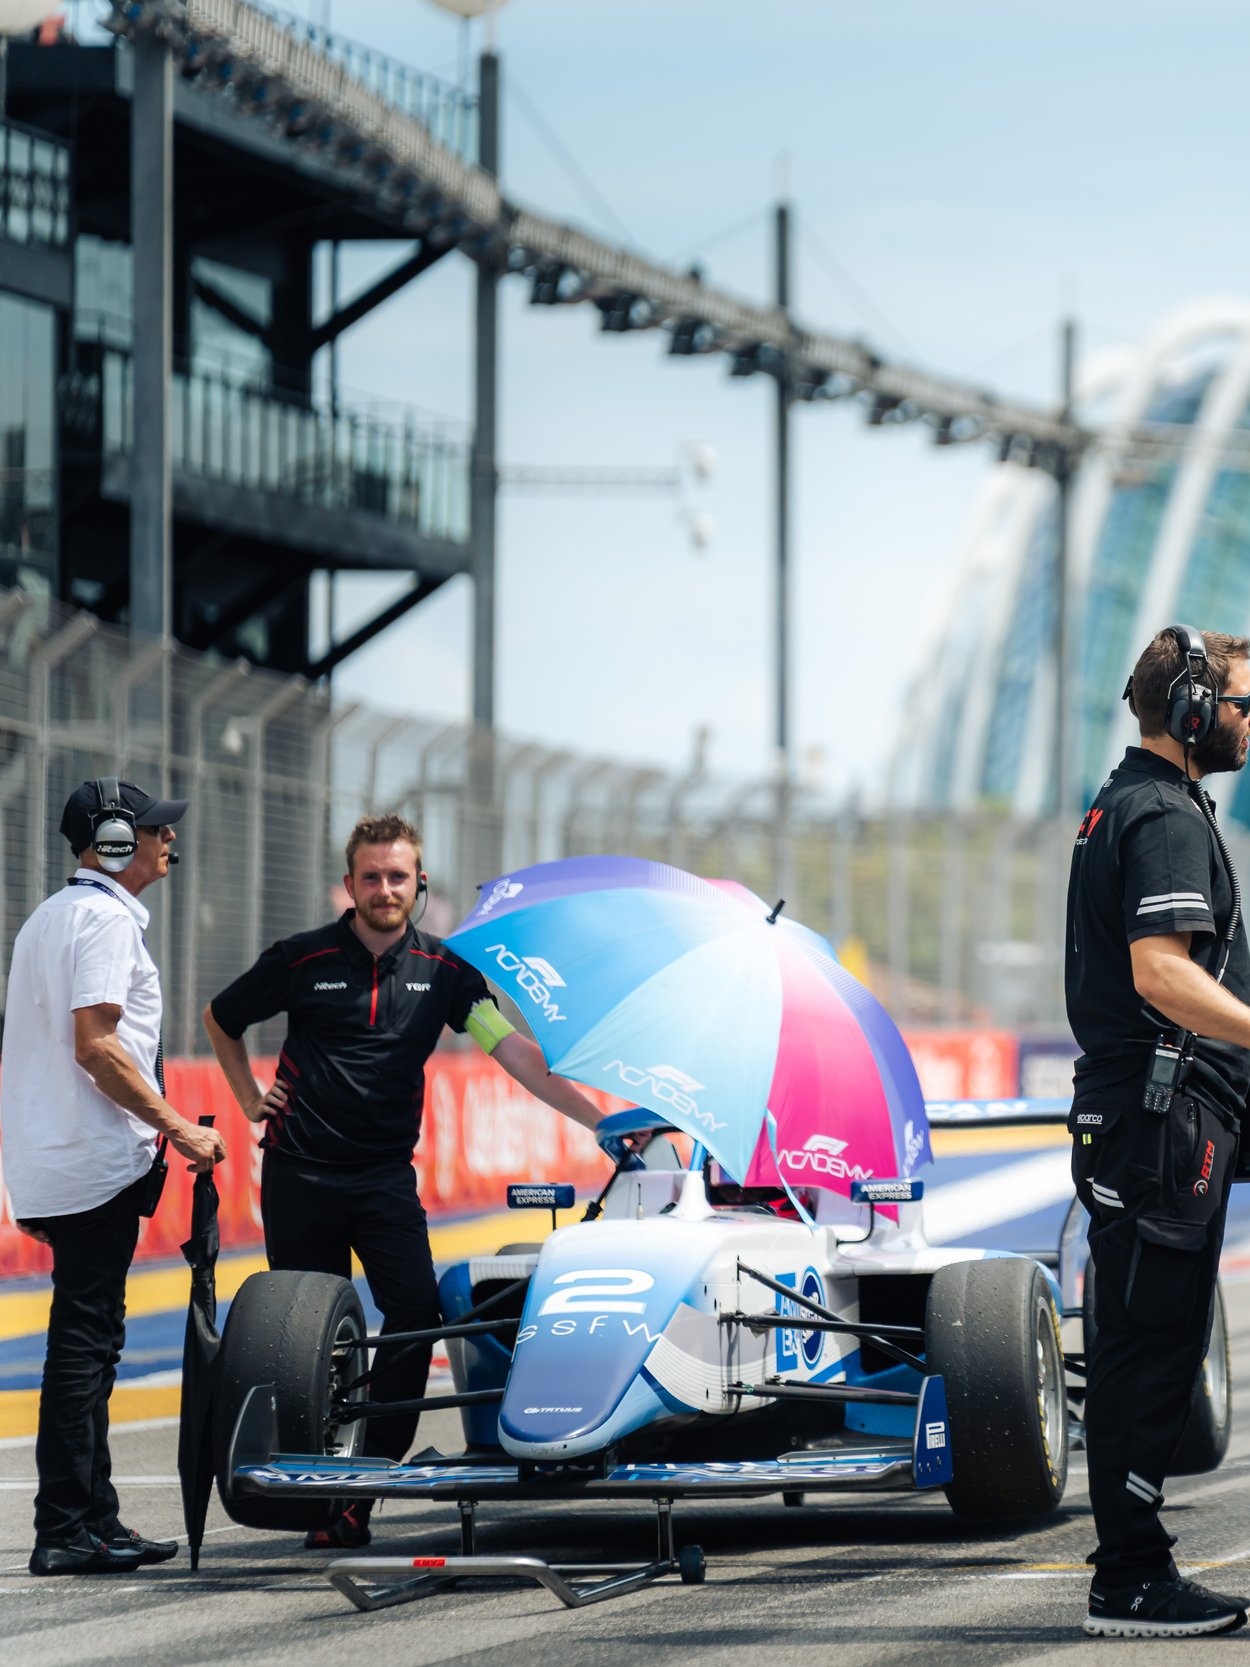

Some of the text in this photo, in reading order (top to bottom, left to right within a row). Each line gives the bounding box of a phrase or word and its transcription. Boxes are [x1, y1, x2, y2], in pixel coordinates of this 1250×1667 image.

[97, 844, 133, 854] Hitech
[484, 943, 567, 1023] ACADEMY
[602, 1059, 728, 1133] ACADEMY
[1077, 1113, 1103, 1123] sparco
[776, 1149, 874, 1180] ACADEMY
[511, 1188, 556, 1197] AMERICAN
[860, 1183, 912, 1193] AMERICAN
[516, 1196, 556, 1205] EXPRESS
[867, 1191, 912, 1200] EXPRESS
[537, 1268, 655, 1317] 2
